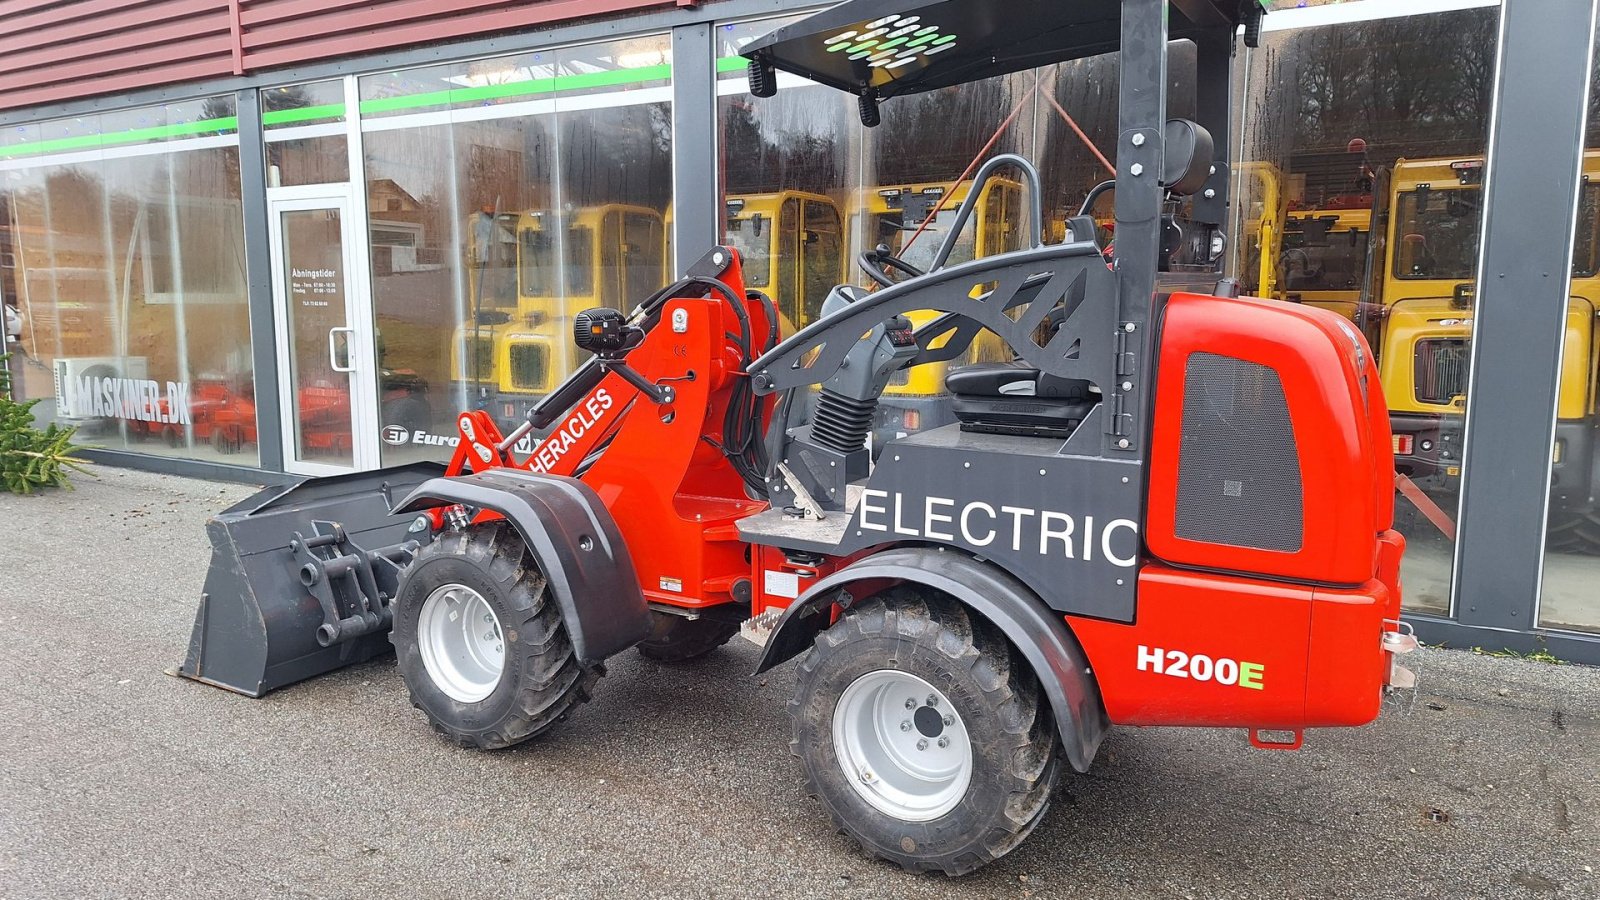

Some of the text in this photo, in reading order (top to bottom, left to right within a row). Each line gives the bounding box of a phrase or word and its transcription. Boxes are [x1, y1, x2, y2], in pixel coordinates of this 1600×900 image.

[528, 387, 614, 474] HERACLES
[859, 488, 1138, 567] ELECTRIC
[1136, 645, 1265, 690] H200E
